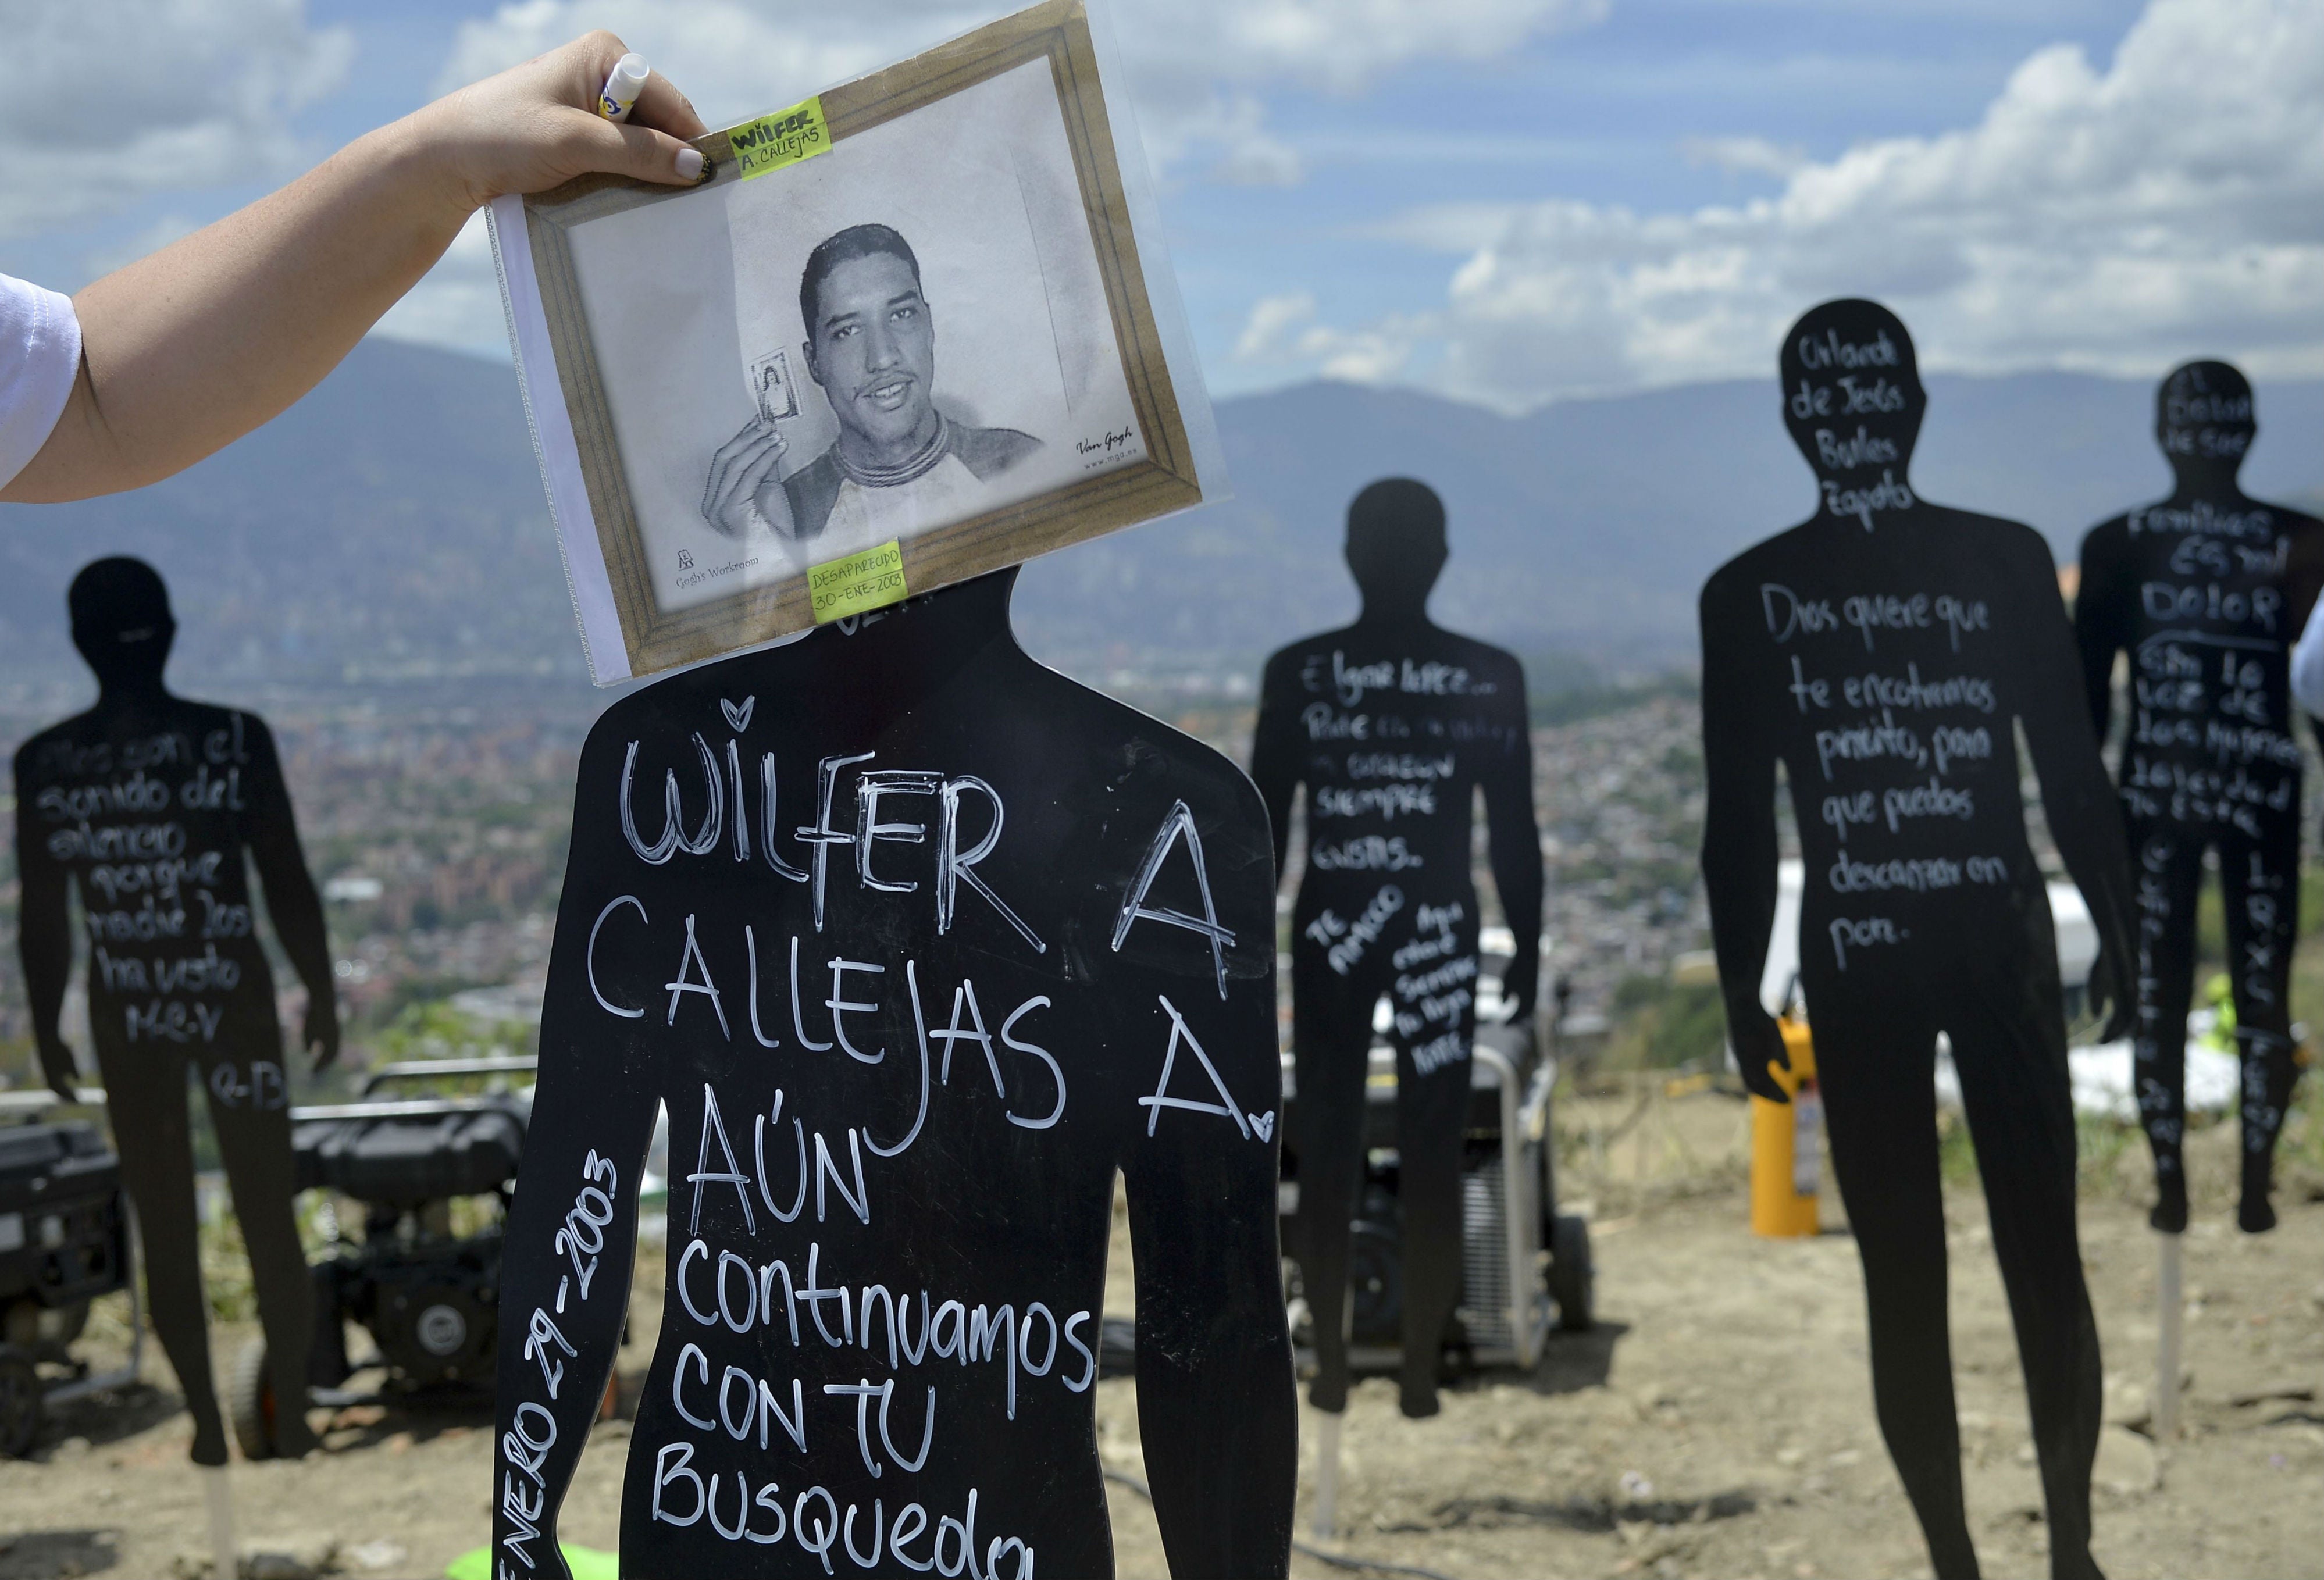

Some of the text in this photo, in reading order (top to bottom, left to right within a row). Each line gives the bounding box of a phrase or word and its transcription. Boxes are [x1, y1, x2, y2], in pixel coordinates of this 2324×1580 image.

[742, 127, 819, 170] A. CALLEJAS
[1076, 426, 1133, 455] Van Gogh
[676, 557, 759, 589] Gogh's Workroom
[812, 550, 899, 590] DESAPARECIDO
[815, 573, 902, 611] 30-ENE-2003
[1760, 583, 1839, 643] Dios
[1934, 595, 1990, 652] que
[1789, 654, 1832, 714] te
[1822, 790, 1876, 843] que
[620, 732, 1236, 1001] WILFER A
[587, 894, 1065, 1157] CALLEJAS
[687, 1083, 871, 1236] AÚN
[672, 1342, 936, 1479] CON TU
